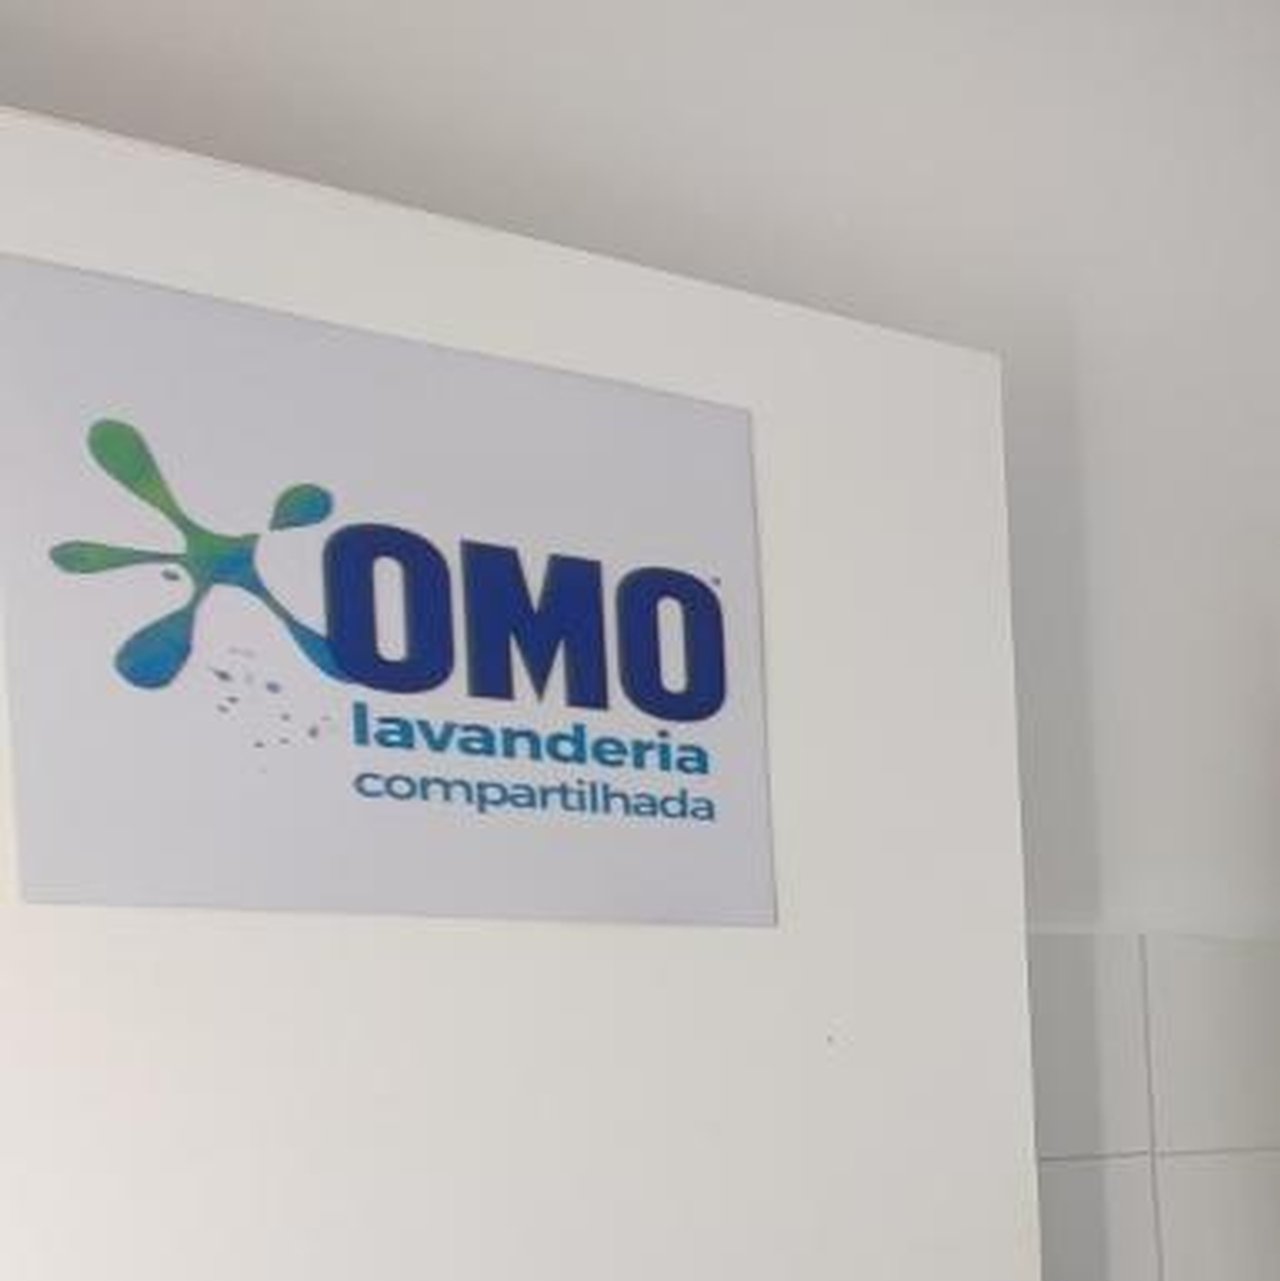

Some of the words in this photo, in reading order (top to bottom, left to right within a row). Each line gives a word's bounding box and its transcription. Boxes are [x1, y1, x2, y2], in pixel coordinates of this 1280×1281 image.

[321, 521, 727, 723] OMO
[352, 701, 711, 775] lavanderia
[353, 770, 717, 822] compartilhada
